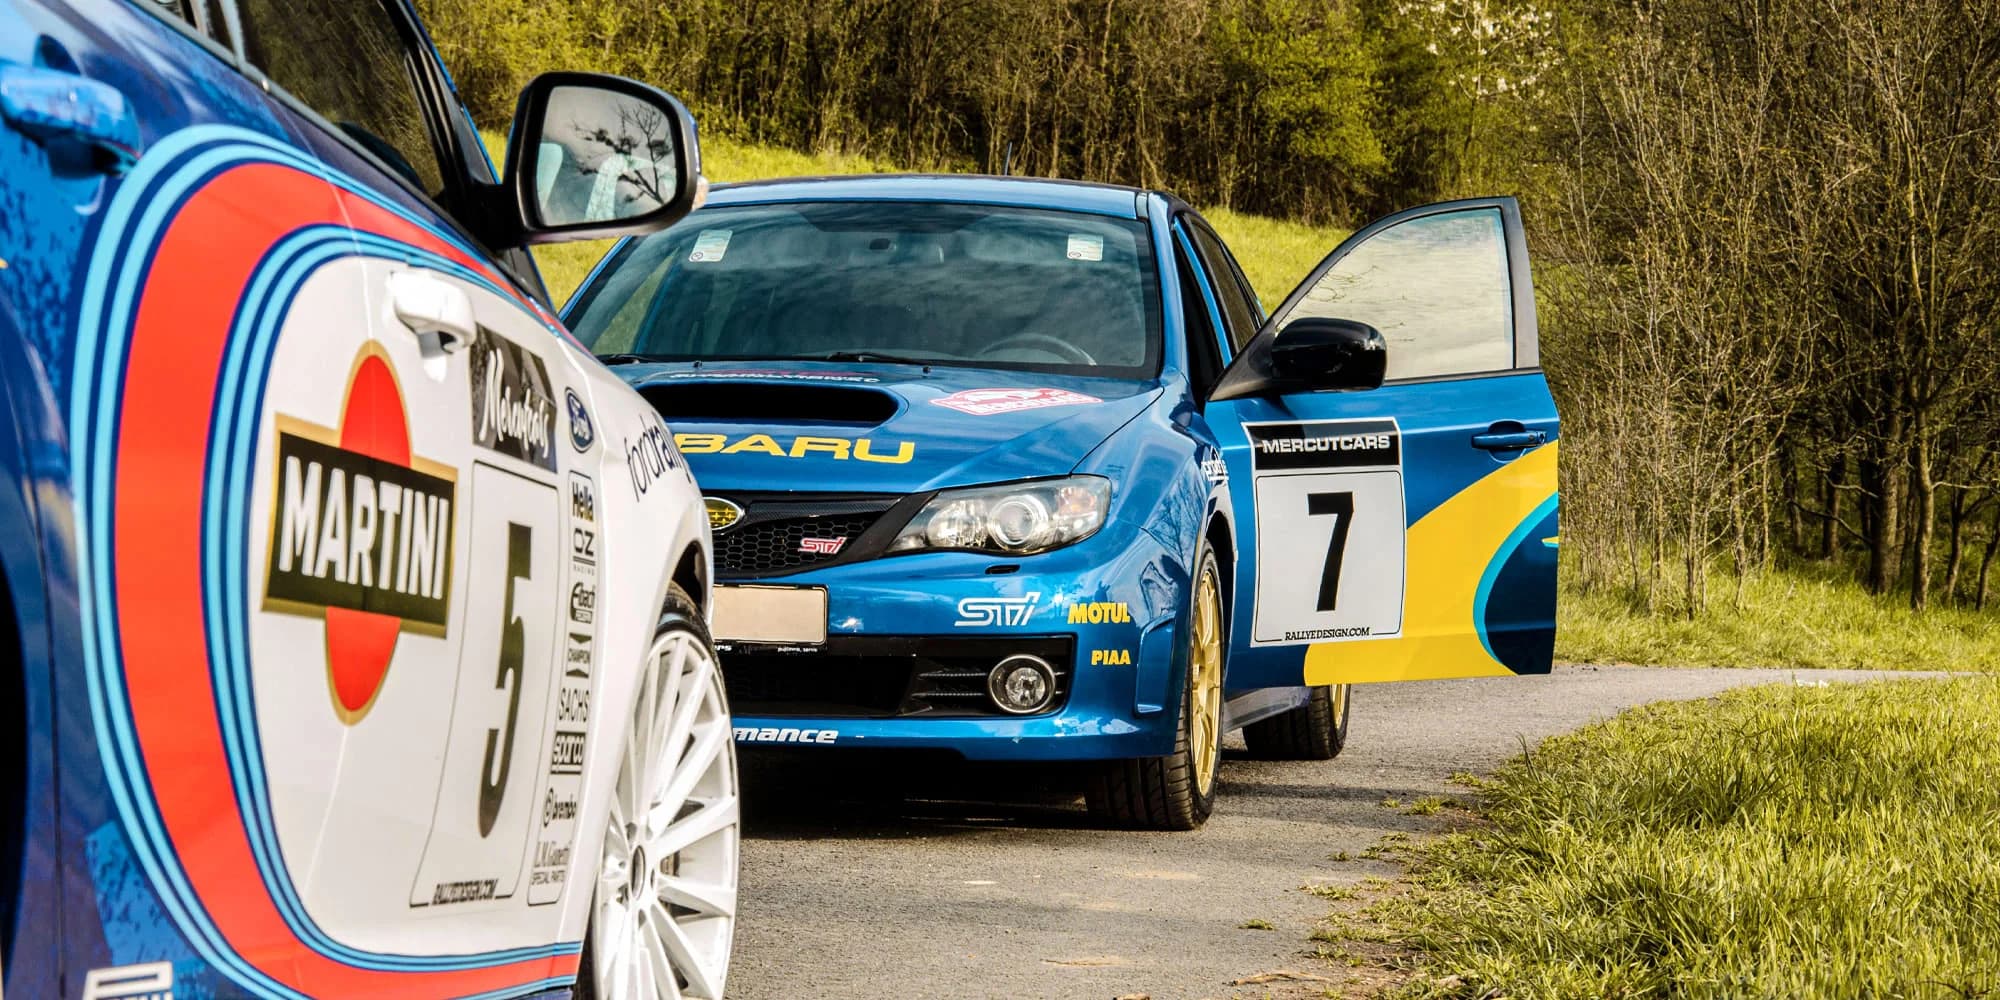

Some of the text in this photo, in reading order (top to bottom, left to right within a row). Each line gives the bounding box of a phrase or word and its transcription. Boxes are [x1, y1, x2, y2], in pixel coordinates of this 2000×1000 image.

[673, 432, 914, 464] BARU
[1262, 436, 1390, 453] MERCUTCARS
[279, 454, 449, 600] MARTINI
[573, 527, 594, 557] OZ
[1308, 491, 1354, 612] 7
[1067, 603, 1130, 624] MOTUL
[1285, 627, 1370, 640] RALLYEDESIGN.COM
[1091, 650, 1131, 665] PIAA
[478, 521, 532, 839] 5
[559, 687, 589, 722] SACHS
[733, 728, 838, 744] mance
